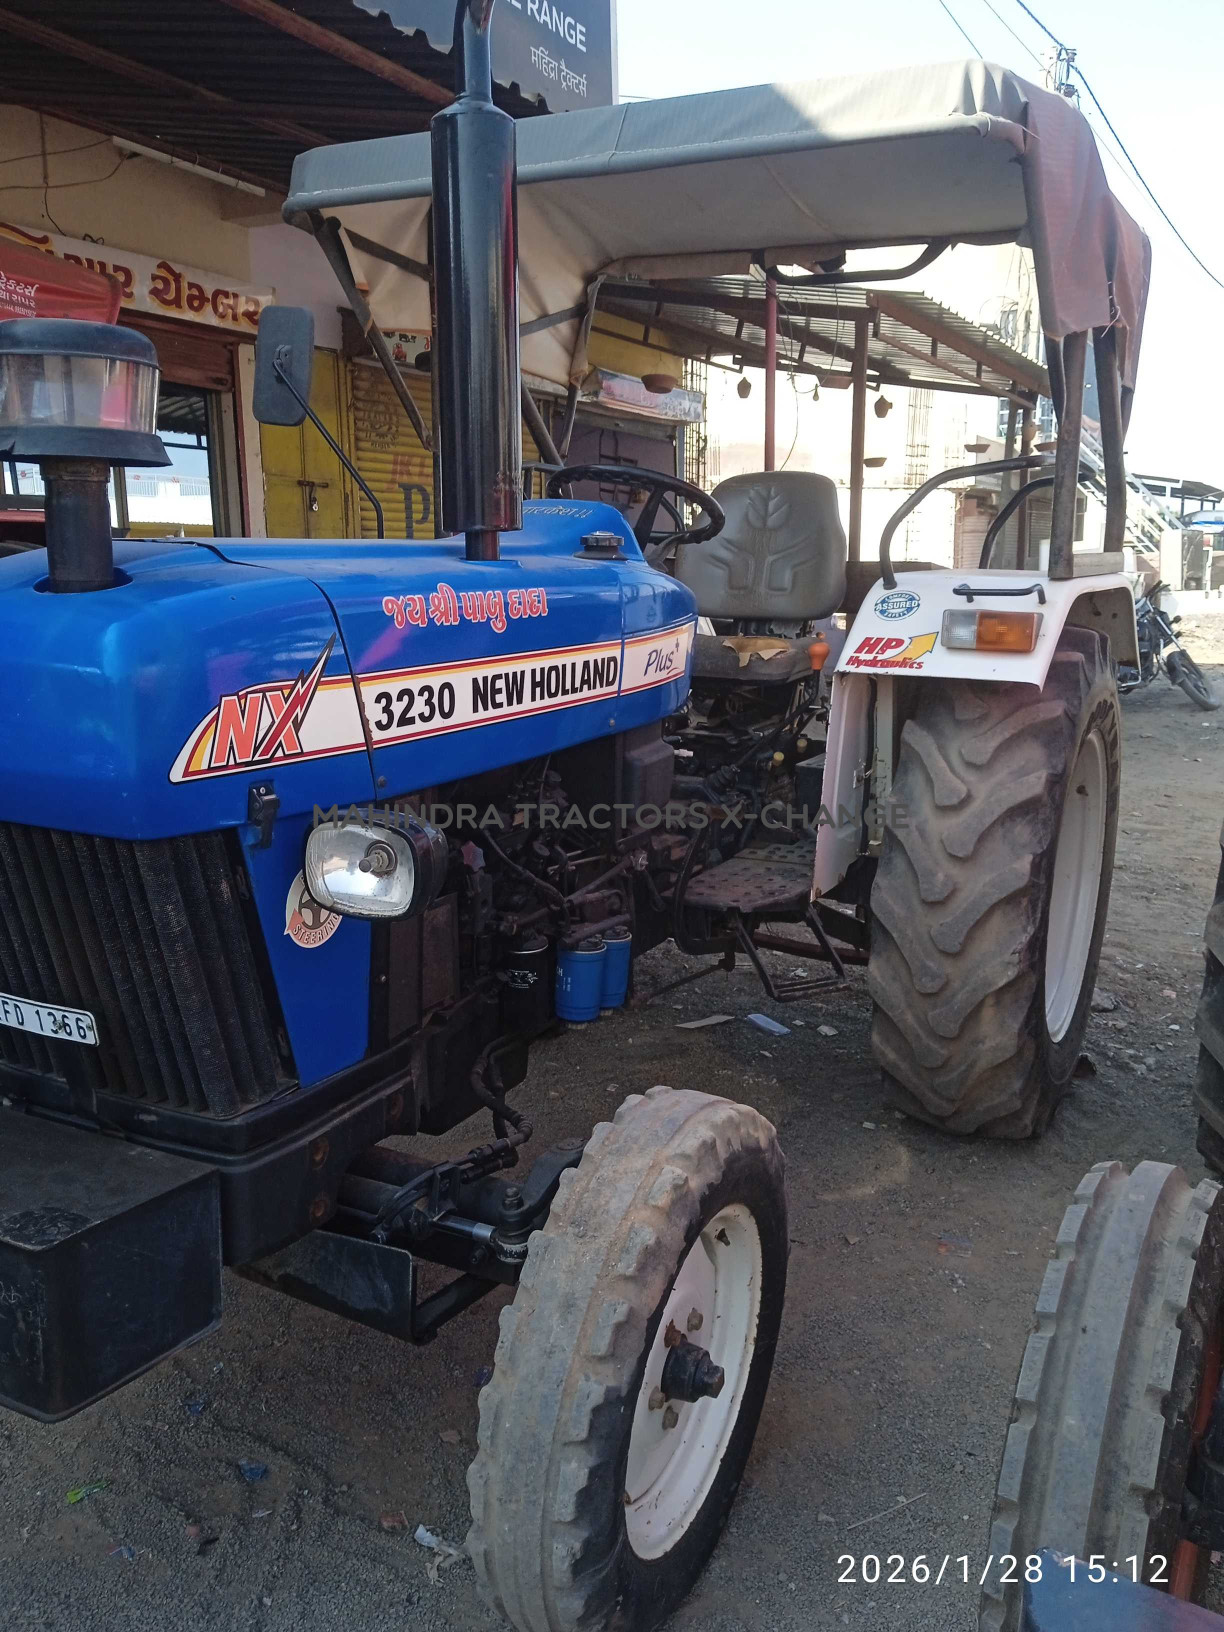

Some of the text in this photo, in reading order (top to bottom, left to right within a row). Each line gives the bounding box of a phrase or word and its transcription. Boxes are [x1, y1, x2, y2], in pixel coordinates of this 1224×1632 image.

[527, 0, 586, 53] RANGE
[382, 594, 428, 629] જય
[428, 582, 460, 626] શ્રી
[875, 600, 918, 611] ASSURED
[853, 637, 905, 654] HP
[845, 656, 924, 669] Hydraulics
[209, 666, 318, 768] NX
[374, 682, 455, 731] 3230
[472, 670, 525, 714] NEW
[530, 656, 619, 702] HOLLAND
[34, 1009, 87, 1040] 1366
